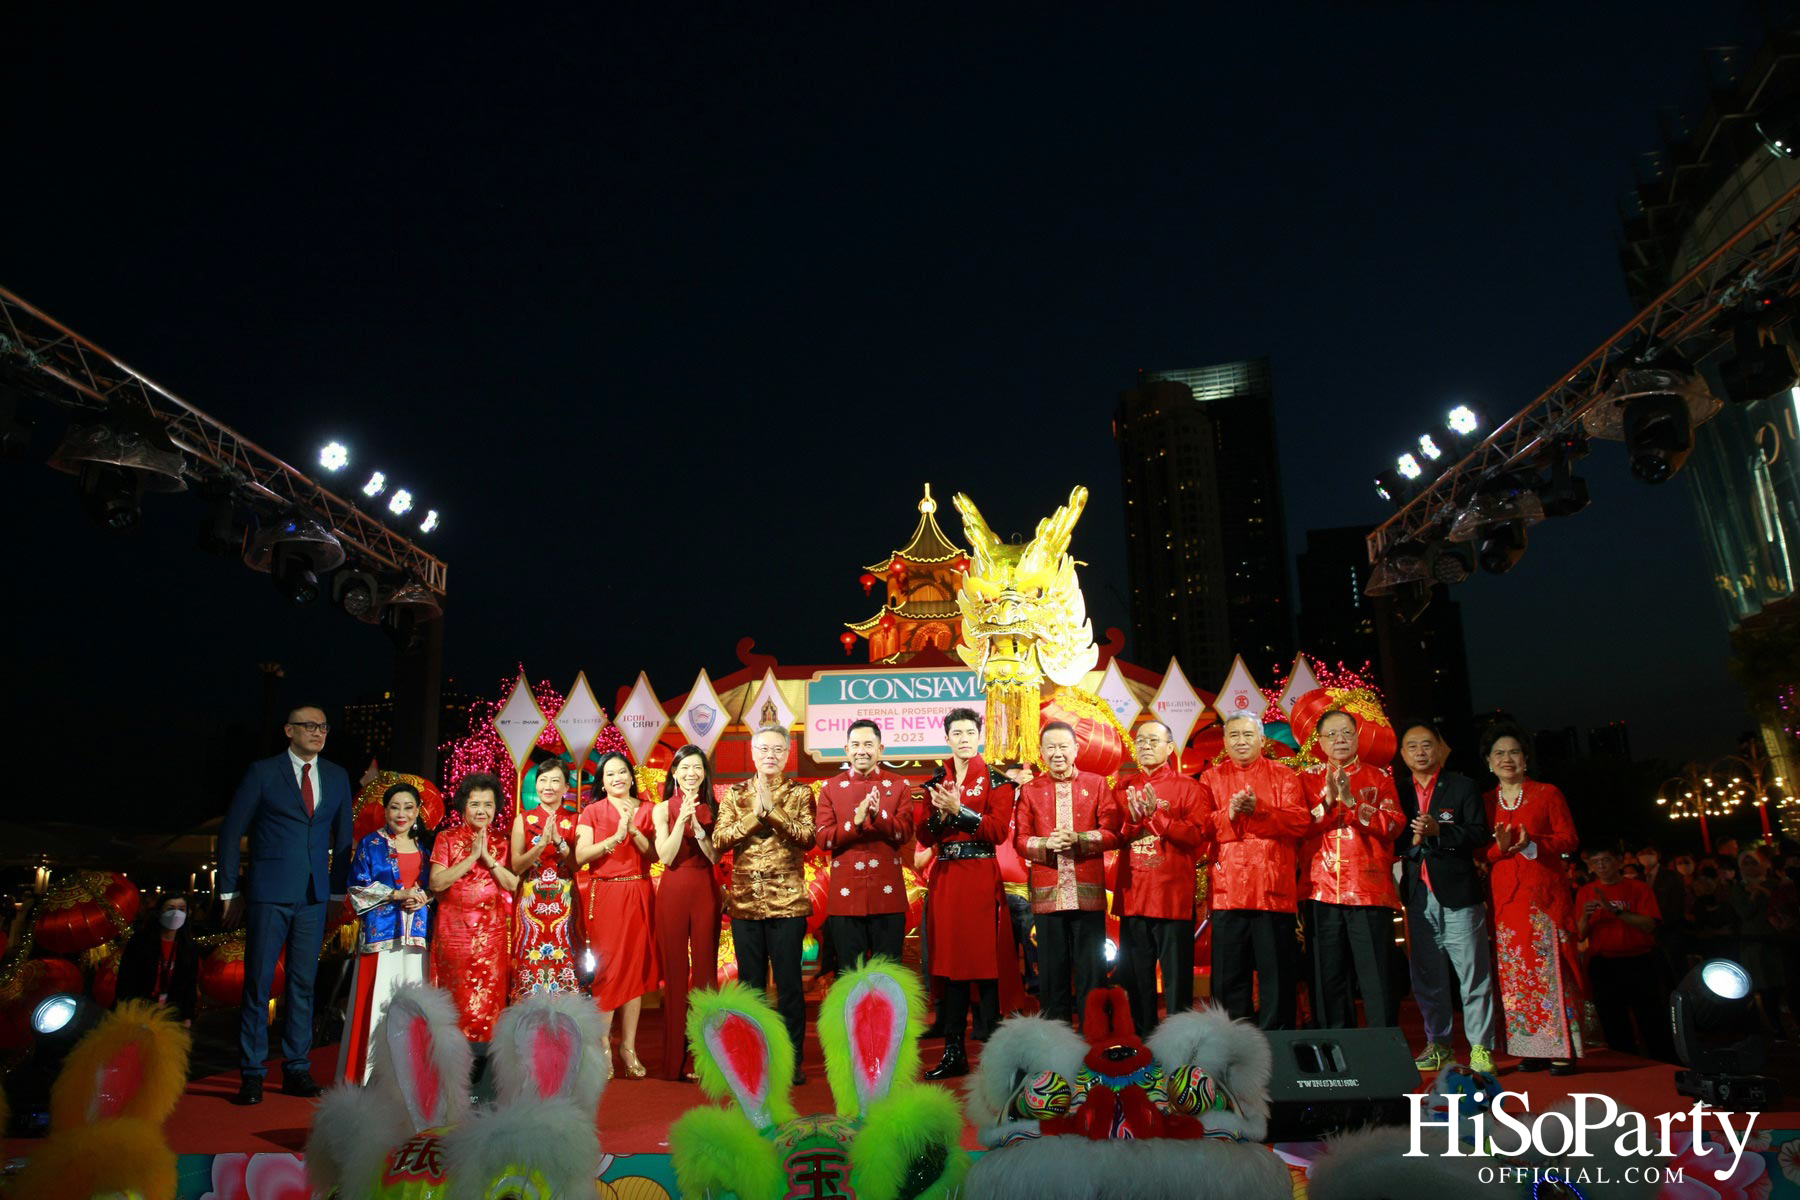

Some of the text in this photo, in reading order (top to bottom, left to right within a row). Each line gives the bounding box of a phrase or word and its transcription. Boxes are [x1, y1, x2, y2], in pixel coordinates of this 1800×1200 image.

[839, 676, 977, 701] ICONSIAM
[857, 706, 955, 716] ETERNAL PROSPERIT
[901, 716, 945, 731] NEW
[893, 732, 924, 742] 2023
